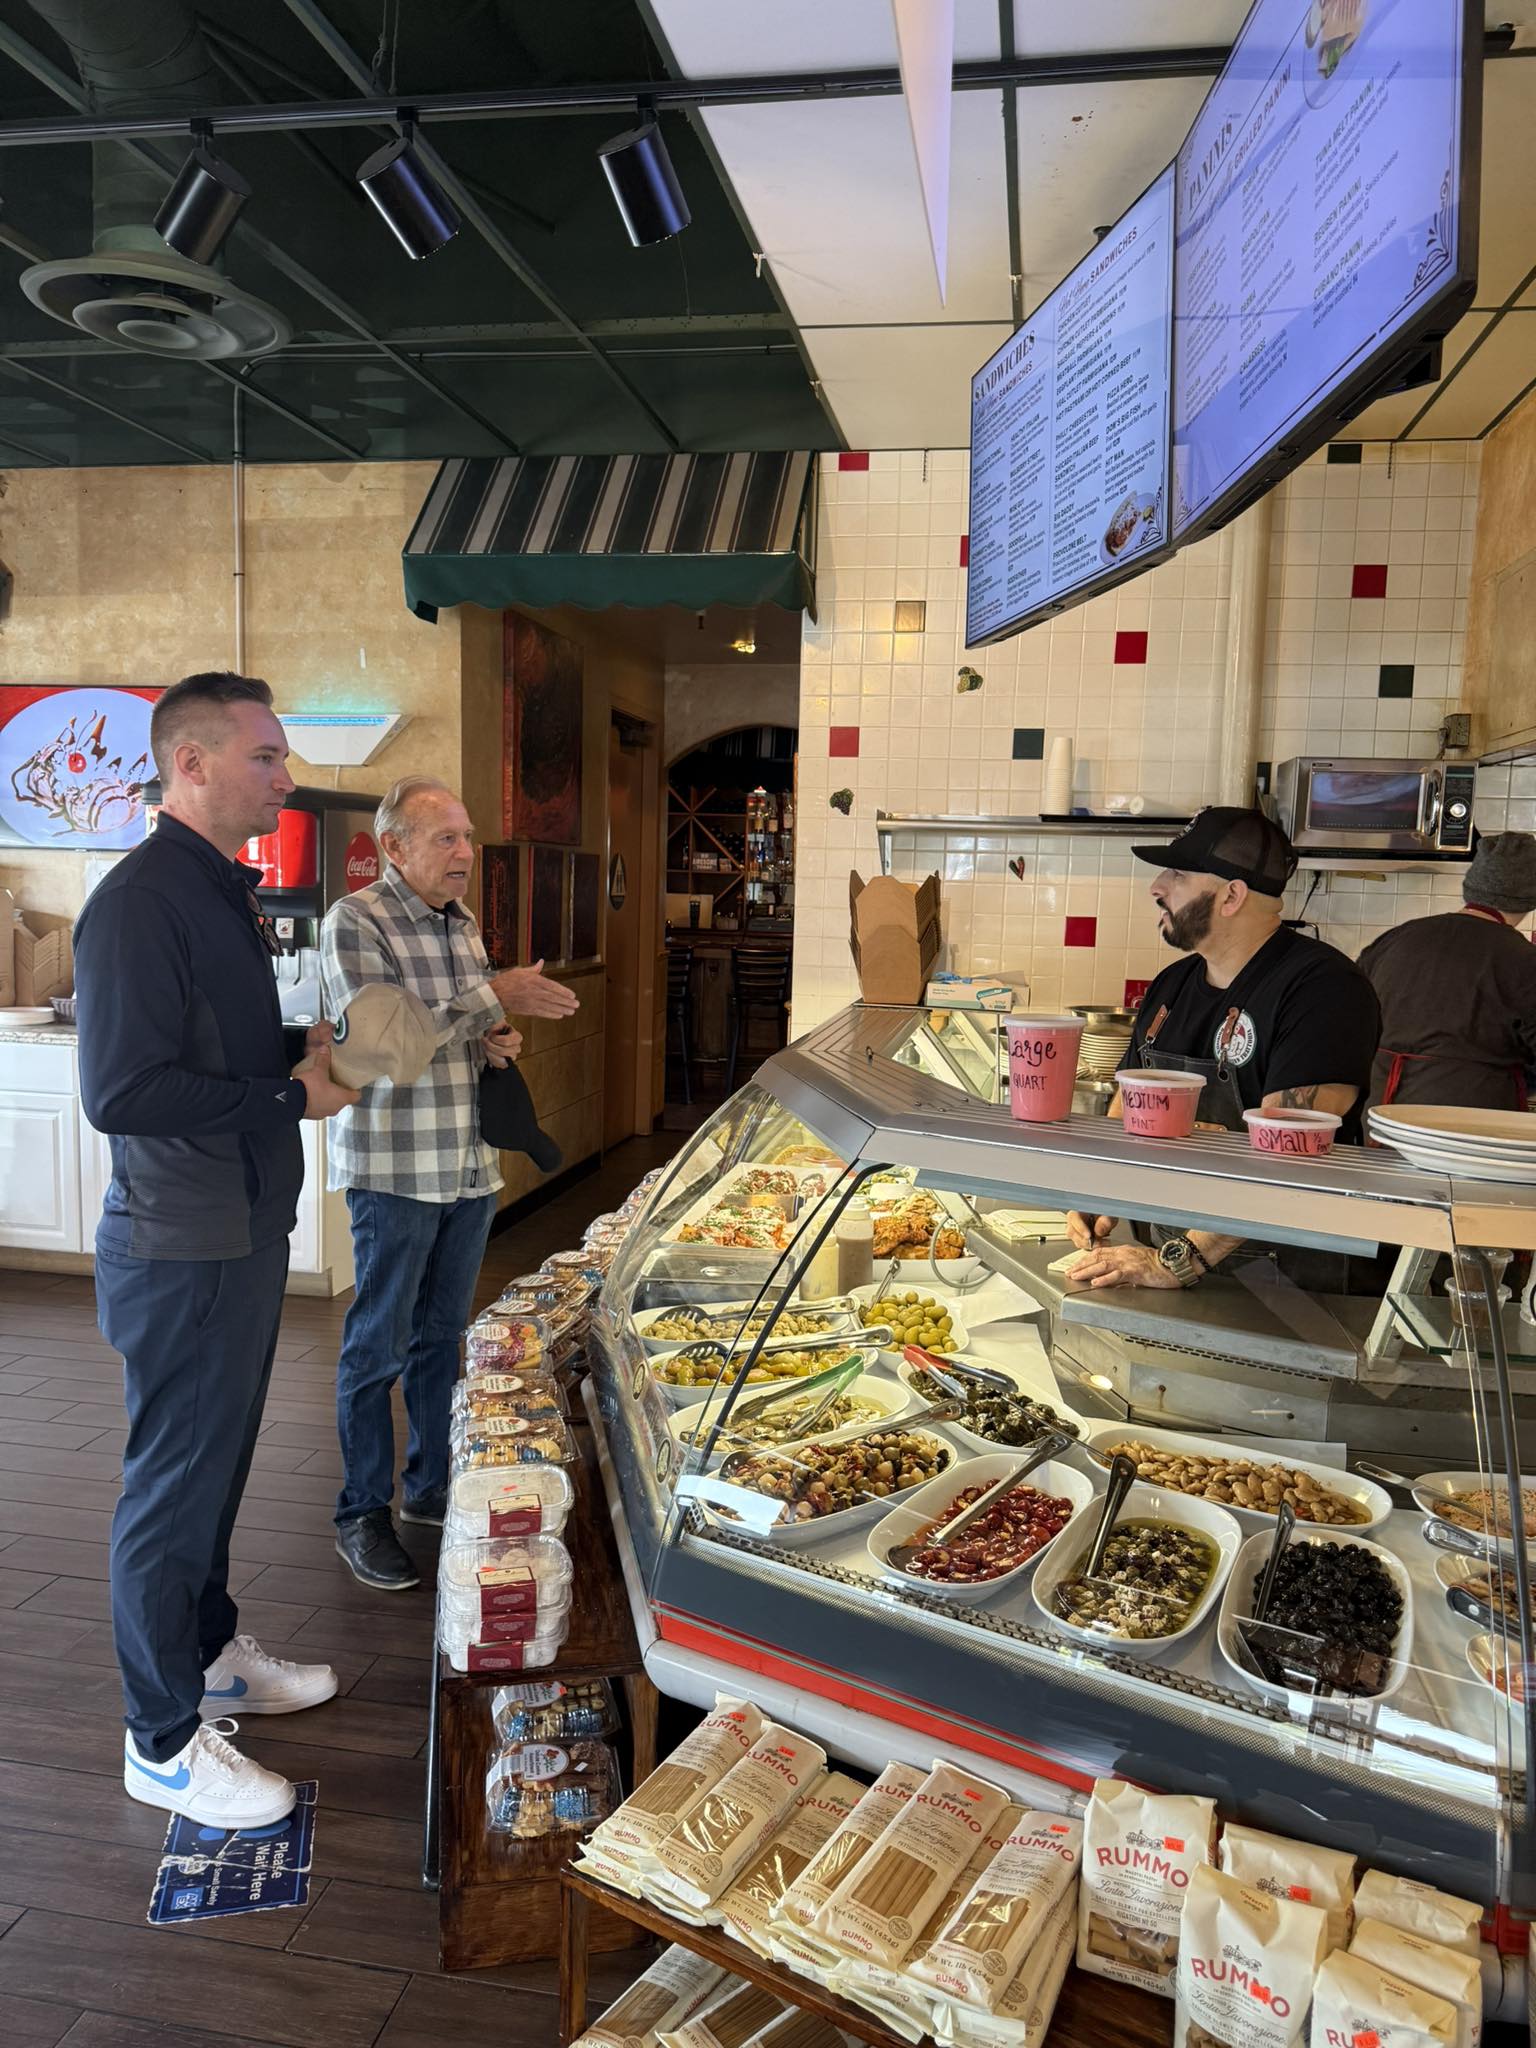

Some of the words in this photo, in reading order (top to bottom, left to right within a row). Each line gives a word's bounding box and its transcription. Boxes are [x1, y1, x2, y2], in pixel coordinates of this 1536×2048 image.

[1233, 109, 1262, 172] GRILLED
[1263, 59, 1291, 121] PANINI
[1315, 134, 1332, 169] TUNA
[1332, 110, 1349, 145] MELT
[1350, 73, 1374, 120] PANINI
[1189, 108, 1232, 212] PANINIS
[1313, 204, 1337, 246] REUBEN
[1338, 174, 1361, 215] PANINI
[1090, 224, 1137, 283] SANDWICHES
[1313, 261, 1339, 302] CUBANO
[1339, 233, 1363, 271] PANINI
[1056, 333, 1074, 356] CHICKEN
[1074, 318, 1090, 339] CUTLET
[1090, 291, 1118, 324] PARMIGIANA
[1076, 327, 1095, 351] PEPPERS
[1094, 324, 1098, 334] &
[1098, 307, 1116, 331] ONIONS
[974, 328, 1035, 405] SANDWICHES
[1056, 358, 1076, 383] MEATBALL
[1076, 334, 1103, 364] PARMIGIANA
[1056, 372, 1076, 396] EGGPLANT
[1076, 348, 1103, 378] PARMIGIANA
[1239, 336, 1266, 376] CALABRESE
[998, 359, 1032, 400] SANDWICHES
[1055, 394, 1066, 409] VEAL
[1066, 381, 1081, 400] CUTLET
[1081, 357, 1108, 387] PARMIGIANA
[1055, 409, 1064, 423] HOT
[1064, 392, 1084, 415] PASTRAMI
[1084, 386, 1091, 399] OR
[1091, 379, 1100, 393] HOT
[1101, 362, 1120, 385] CORNED
[1119, 352, 1131, 369] BEEF
[1106, 384, 1119, 401] PIZZA
[1119, 372, 1133, 391] HERO
[1055, 426, 1068, 443] PHILLY
[1068, 402, 1098, 432] CHEESESTEAK
[1120, 410, 1129, 423] BIG
[1129, 401, 1141, 417] FISH
[1054, 455, 1071, 473] CHICAGO
[1070, 442, 1088, 461] ITALIAN
[1088, 434, 1099, 448] BEEF
[1054, 461, 1076, 483] SANDWICH
[1104, 455, 1113, 468] HIT
[1113, 448, 1124, 462] MAN
[1053, 510, 1062, 522] BIG
[1061, 501, 1074, 516] DADDY
[1052, 539, 1076, 560] PROVOLONE
[1076, 533, 1087, 546] MELT
[1013, 1073, 1048, 1091] QUART
[917, 1794, 982, 1834] RUMMO
[603, 1845, 629, 1861] RUMMO
[614, 1829, 641, 1844] RUMMO
[1006, 1836, 1074, 1862] RUMMO
[254, 1843, 272, 1870] Wait
[270, 1841, 290, 1880] Please
[594, 1862, 621, 1880] RUMMO
[665, 1849, 677, 1861] Wt.
[678, 1856, 690, 1867] 1lb
[689, 1862, 711, 1885] (454g)
[1096, 1846, 1190, 1888] RUMMO
[249, 1871, 268, 1901] Here
[1096, 1880, 1125, 1897] Lenta
[1116, 1910, 1140, 1923] RIGATONI
[1118, 1902, 1137, 1912] SLOWLY
[832, 1905, 847, 1917] Net
[847, 1911, 861, 1924] Wt.
[862, 1919, 874, 1933] 1lb
[874, 1928, 900, 1949] (454g)
[841, 1929, 873, 1951] RUMMO
[936, 1973, 969, 1994] RUMMO
[940, 1957, 954, 1969] Wt.
[955, 1960, 967, 1970] 1lb
[968, 1964, 995, 1985] (454g)
[1103, 1967, 1115, 1975] Net
[1117, 1971, 1130, 1981] Wt.
[1131, 1974, 1142, 1983] 1lb
[1143, 1979, 1166, 1992] (454g)
[1191, 1990, 1220, 2014] Lenta
[1220, 2004, 1286, 2044] Lavorazione
